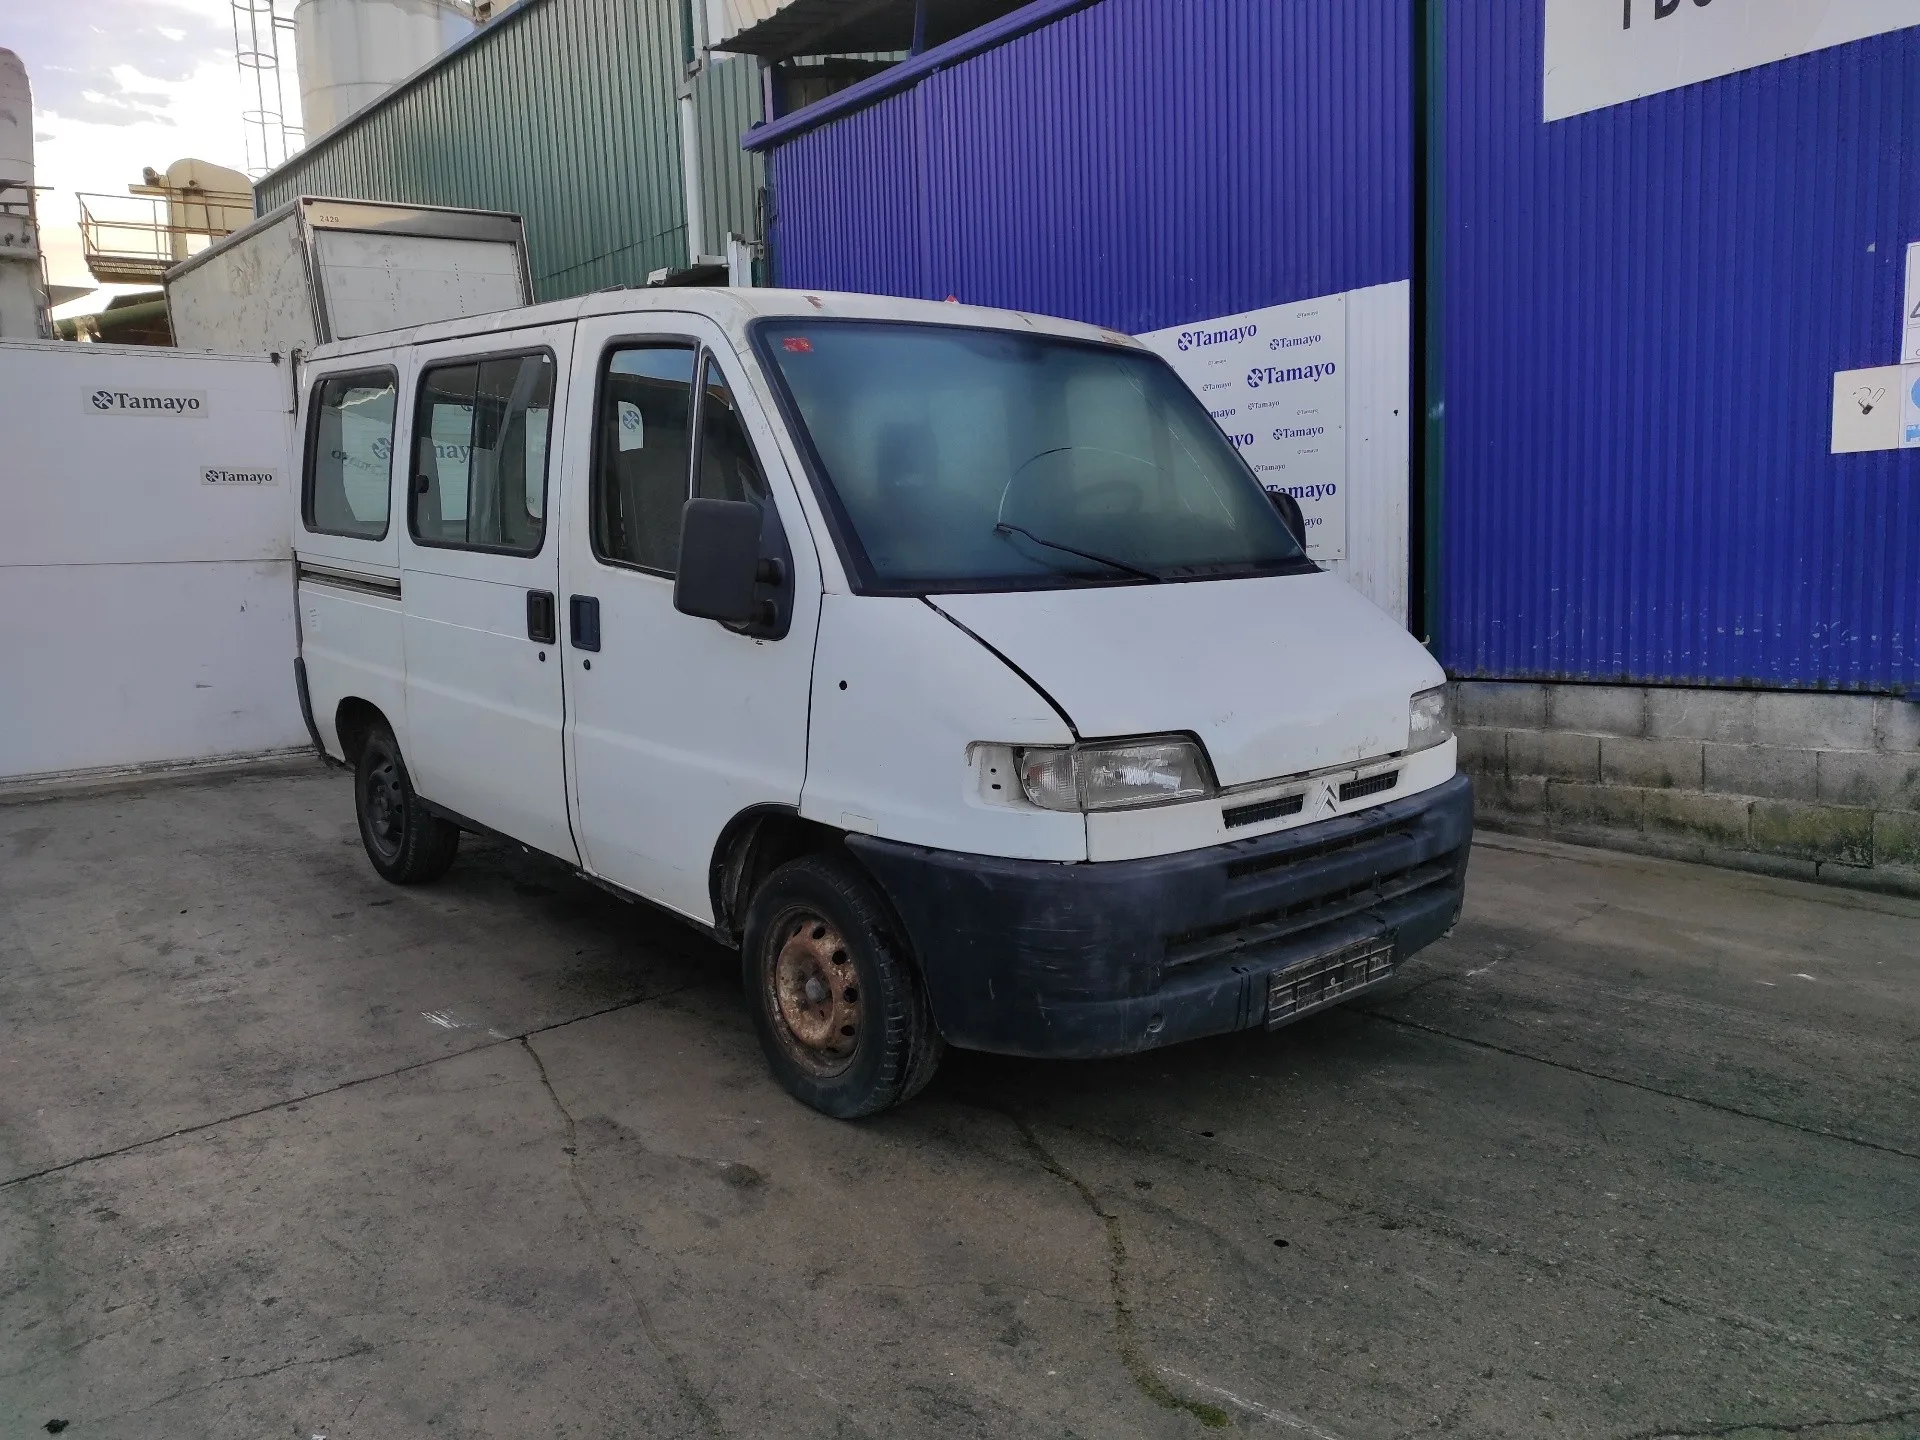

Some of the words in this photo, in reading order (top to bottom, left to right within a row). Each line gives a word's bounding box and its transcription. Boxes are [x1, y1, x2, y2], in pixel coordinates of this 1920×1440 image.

[1193, 324, 1257, 347] Tamayo
[1279, 334, 1321, 348] Tamayo
[1264, 362, 1336, 386] Tamayo
[1208, 381, 1232, 390] Tamayo
[114, 392, 200, 414] Tamayo
[1255, 400, 1280, 409] Tamayo
[1210, 408, 1236, 420] mayo
[1282, 426, 1324, 439] Tamayo
[1260, 464, 1286, 472] Tamayo
[219, 471, 273, 484] Tamayo
[1304, 517, 1322, 528] ayo
